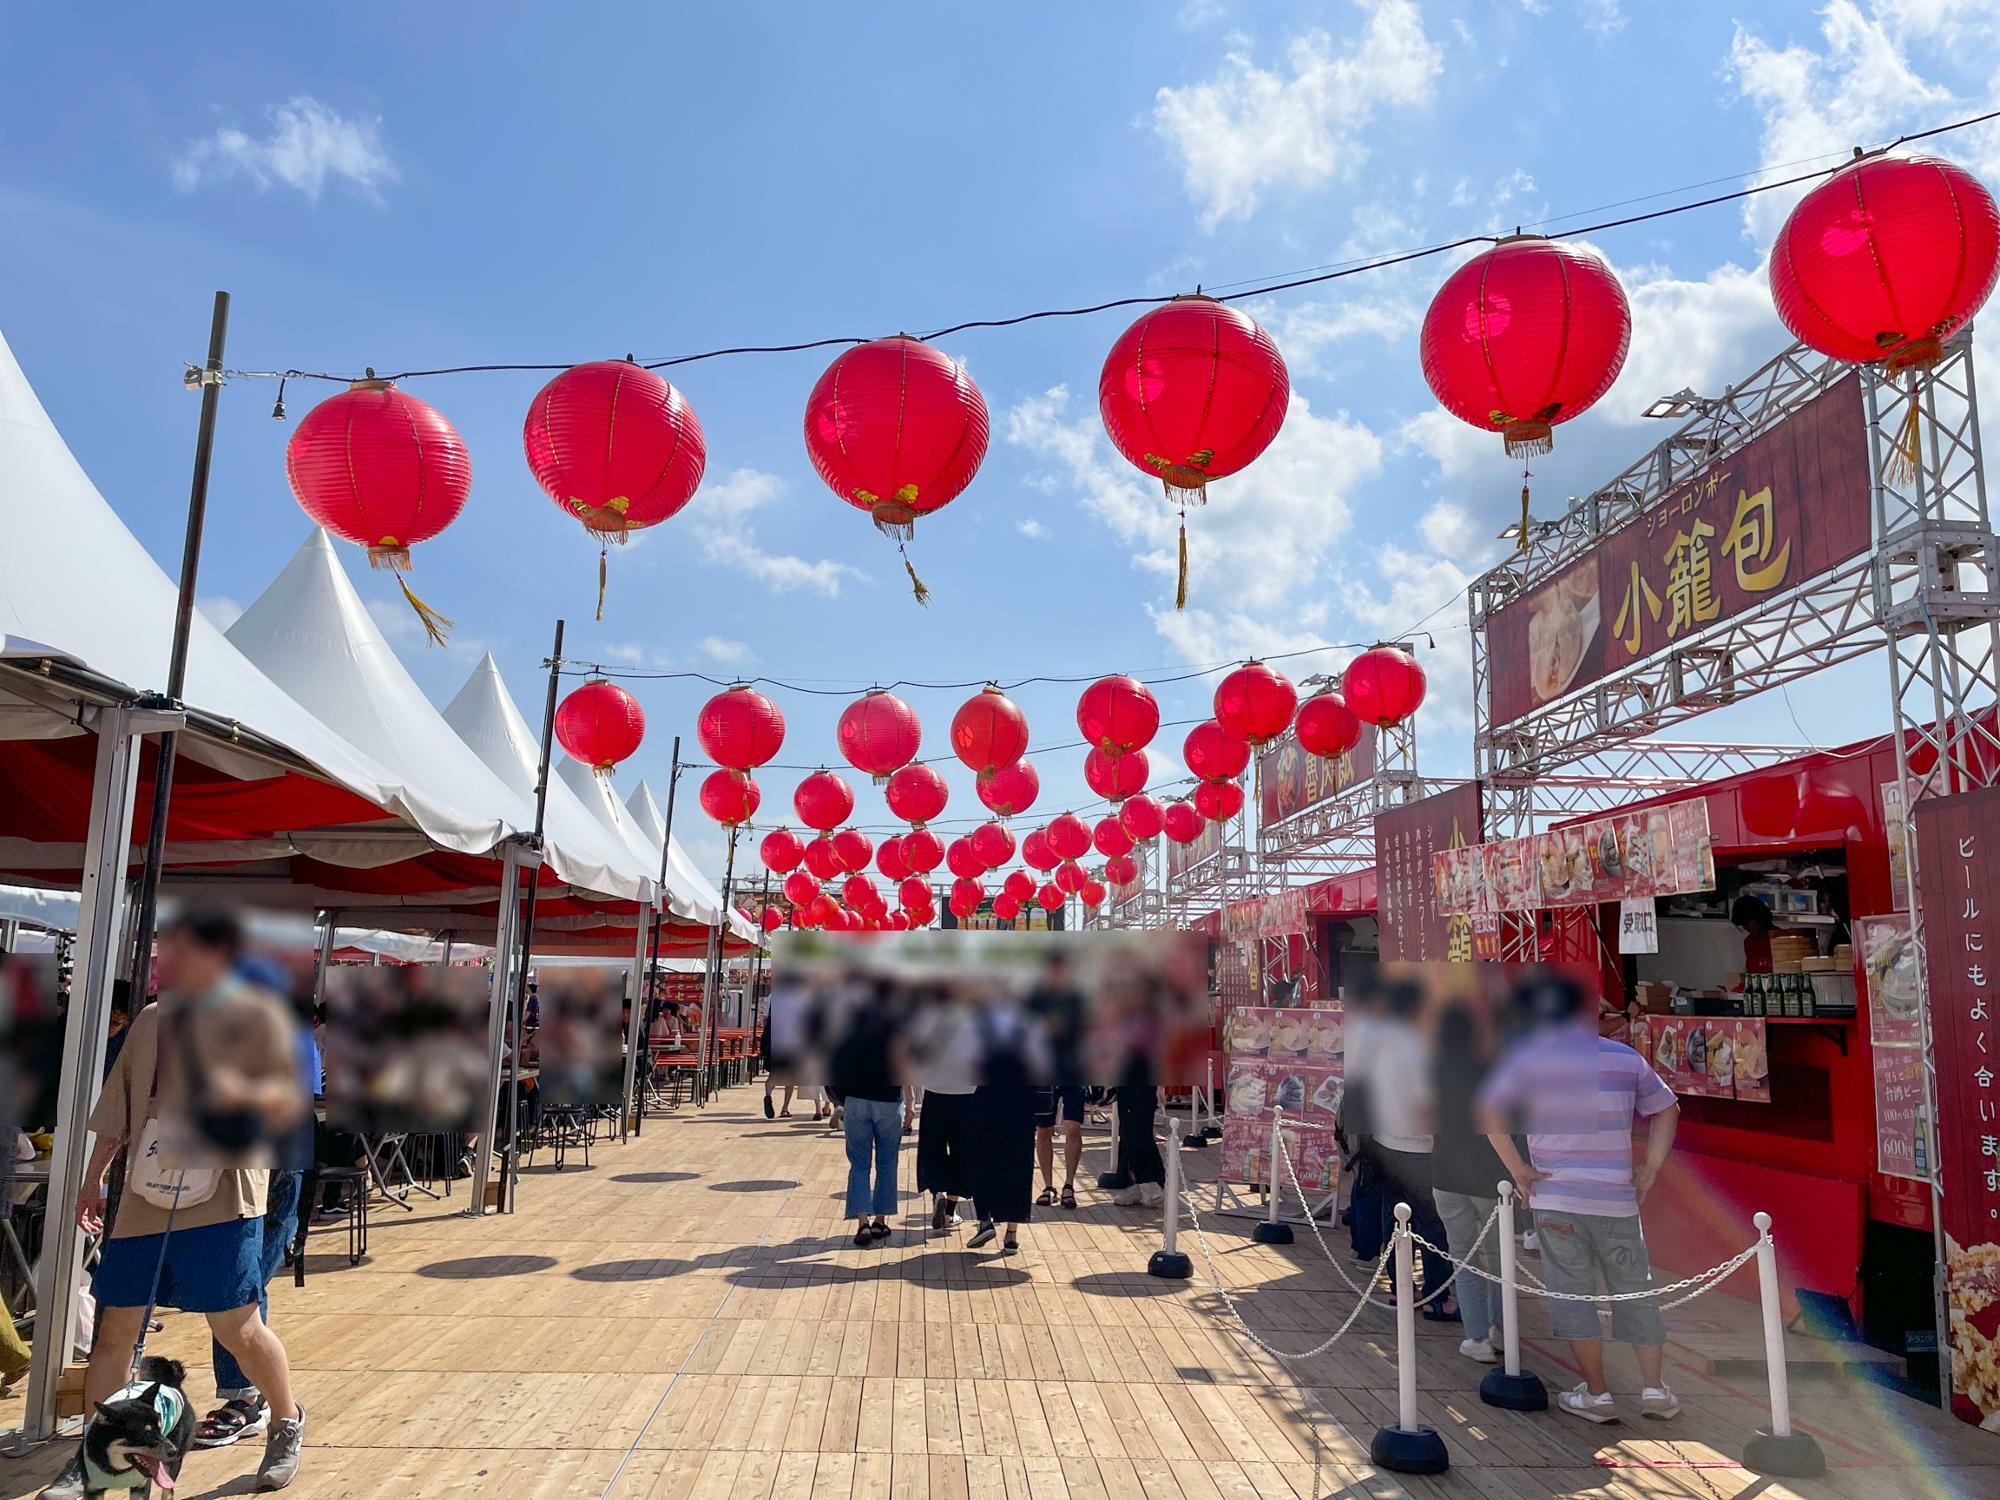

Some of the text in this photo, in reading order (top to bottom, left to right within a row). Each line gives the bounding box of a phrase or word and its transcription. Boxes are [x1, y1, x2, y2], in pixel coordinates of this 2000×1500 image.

[1647, 471, 1732, 538] ショーロンポー
[1612, 486, 1791, 656] 小籠包
[1623, 911, 1653, 934] 受取口
[1958, 835, 2000, 1219] ビールにもよく合います。
